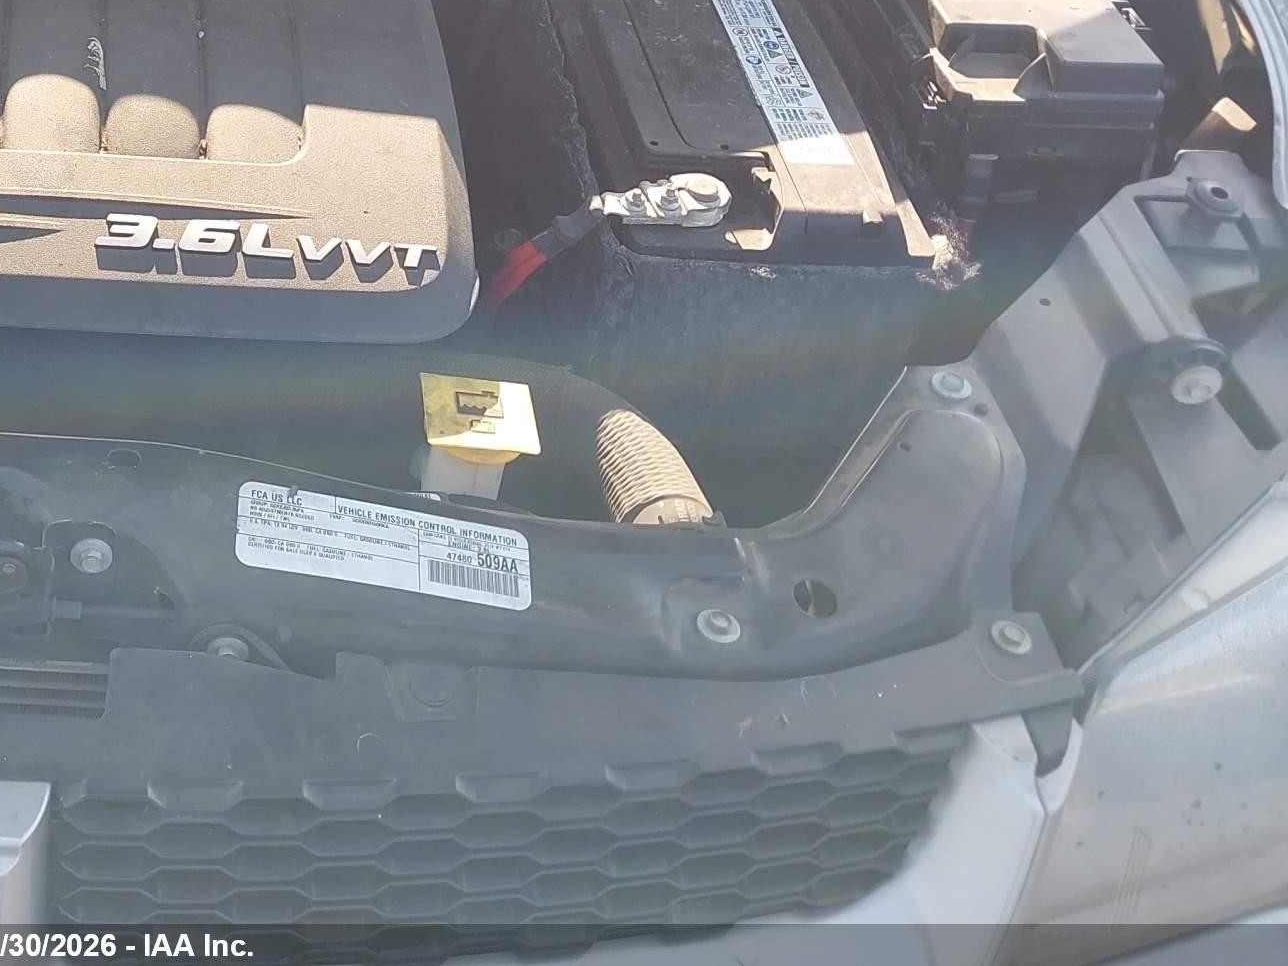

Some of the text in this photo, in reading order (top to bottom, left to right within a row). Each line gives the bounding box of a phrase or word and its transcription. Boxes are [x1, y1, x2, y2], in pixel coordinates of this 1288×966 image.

[251, 489, 268, 500] FCA
[271, 492, 284, 503] US
[337, 505, 372, 519] VEHICLE
[375, 513, 416, 527] EMISSION
[418, 520, 456, 535] CONTROL
[459, 528, 518, 547] INFORMATION
[477, 553, 519, 575] 509AA
